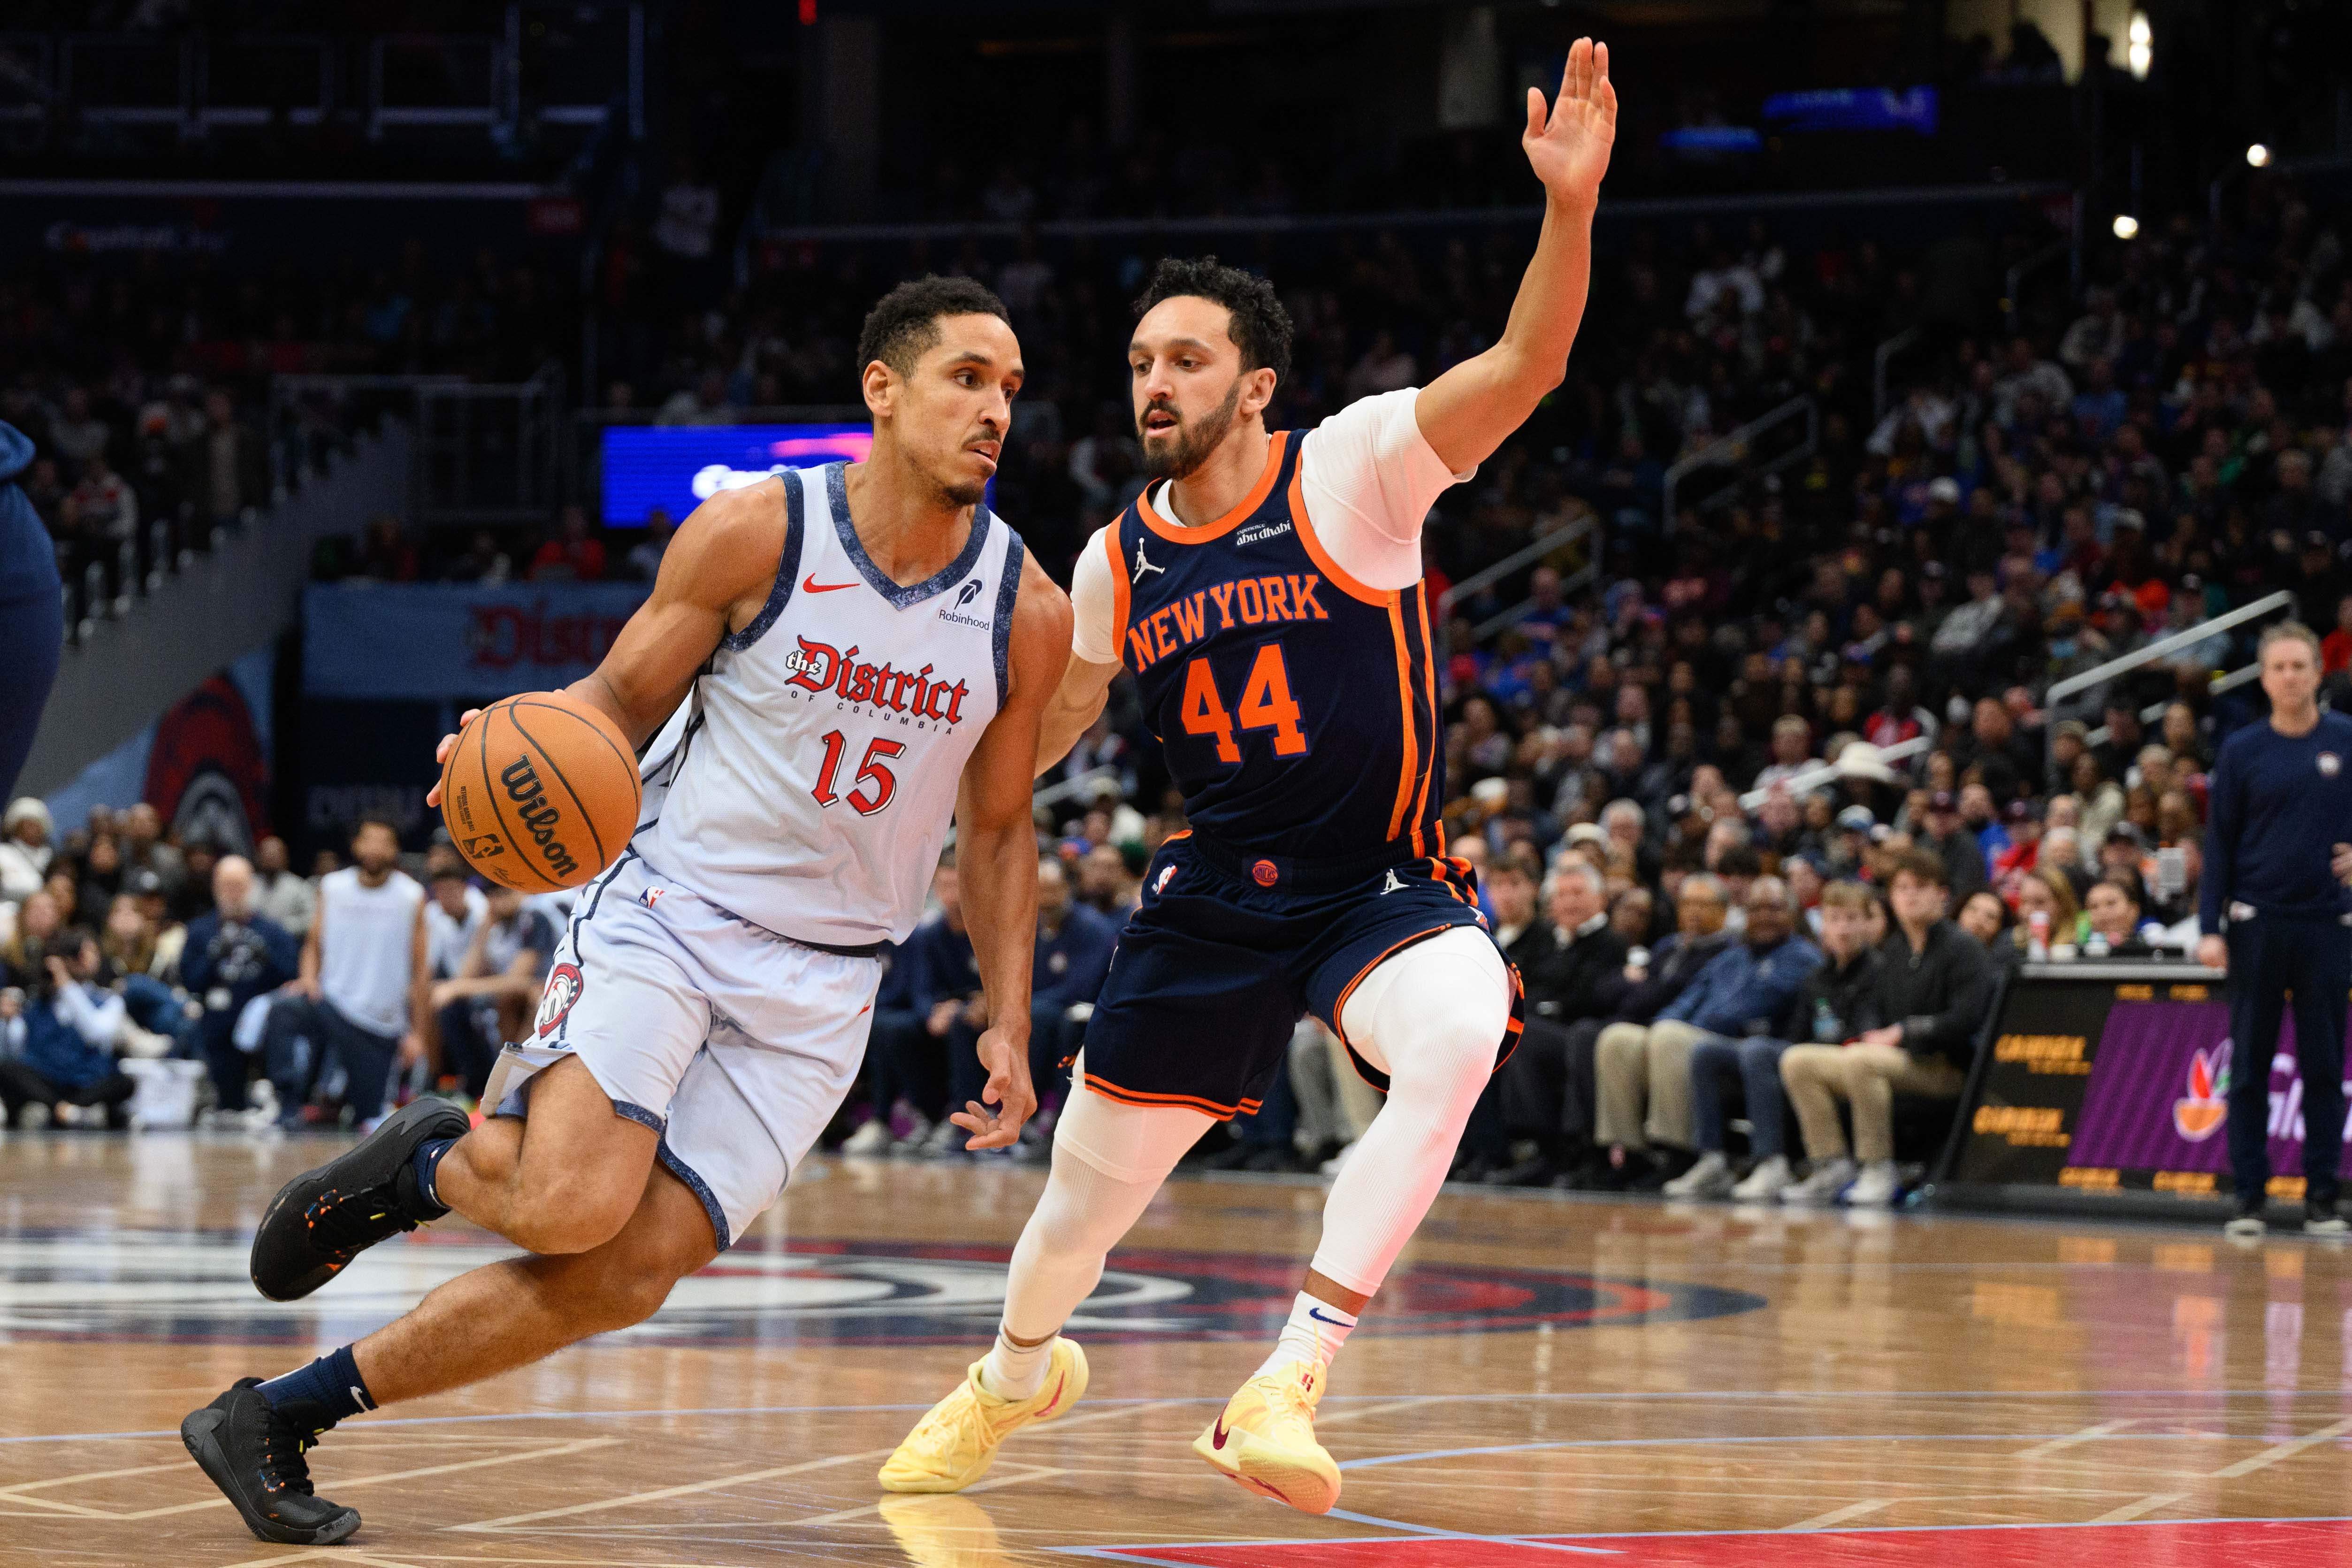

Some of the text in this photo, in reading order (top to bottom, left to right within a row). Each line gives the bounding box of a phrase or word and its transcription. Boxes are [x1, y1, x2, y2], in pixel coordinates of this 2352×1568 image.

[1237, 523, 1266, 535] experience
[1237, 520, 1291, 545] abu dhabi
[939, 610, 990, 631] Robinhood
[1127, 573, 1329, 674] NEW YORK
[784, 635, 969, 725] the District
[790, 690, 952, 735] OF COLUMBIA
[1179, 641, 1310, 766] 44
[501, 753, 579, 877] Wilson
[810, 729, 907, 817] 15
